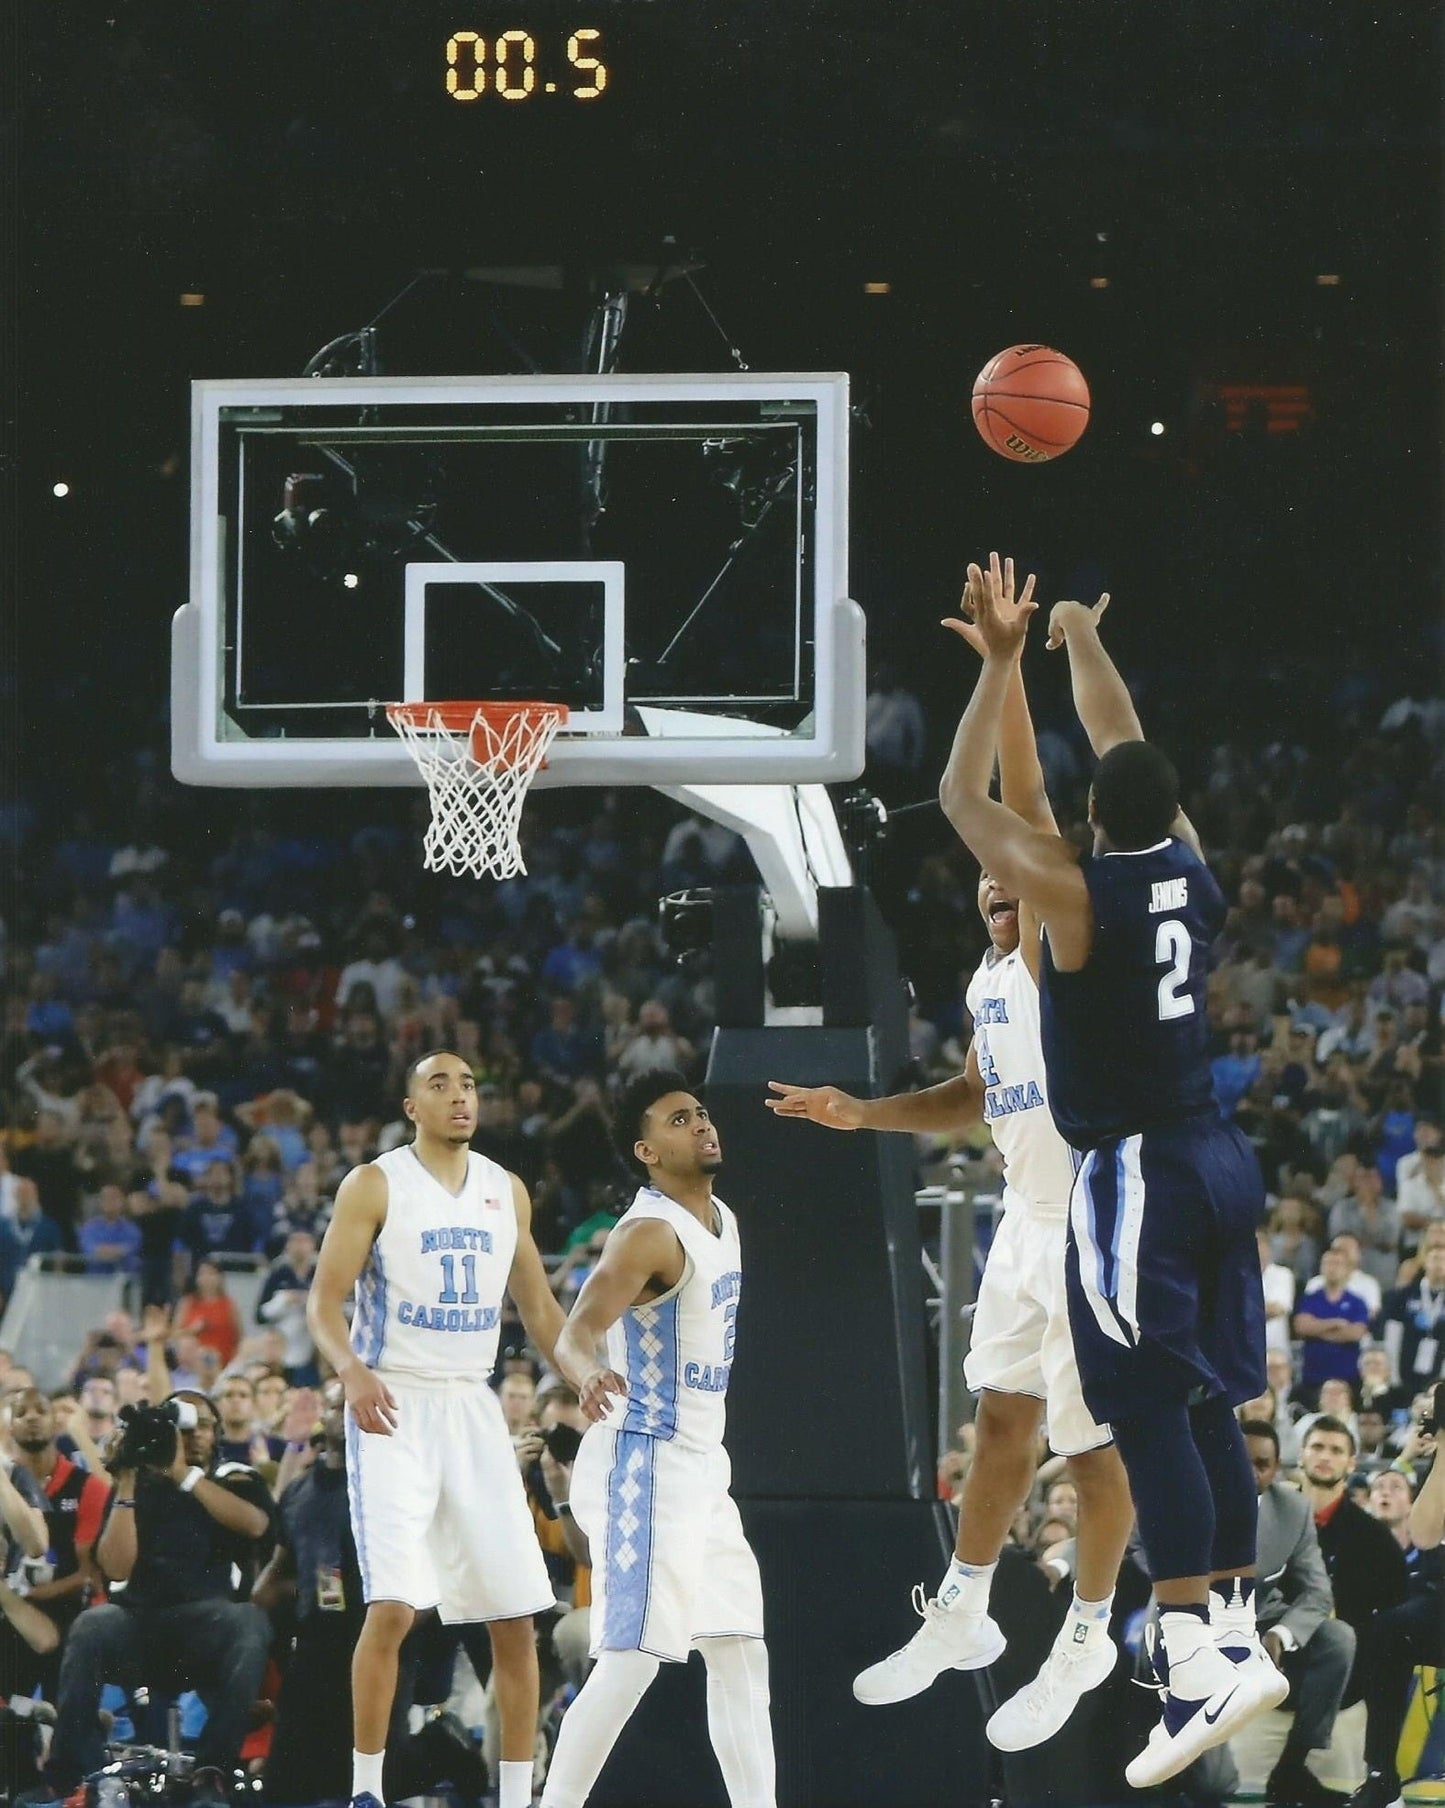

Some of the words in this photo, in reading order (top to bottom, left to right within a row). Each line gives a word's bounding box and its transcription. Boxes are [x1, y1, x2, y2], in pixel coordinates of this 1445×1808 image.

[446, 29, 607, 100] 00.5
[1155, 919, 1195, 1021] 2
[420, 1227, 494, 1255] NORTH
[438, 1254, 480, 1304] 11
